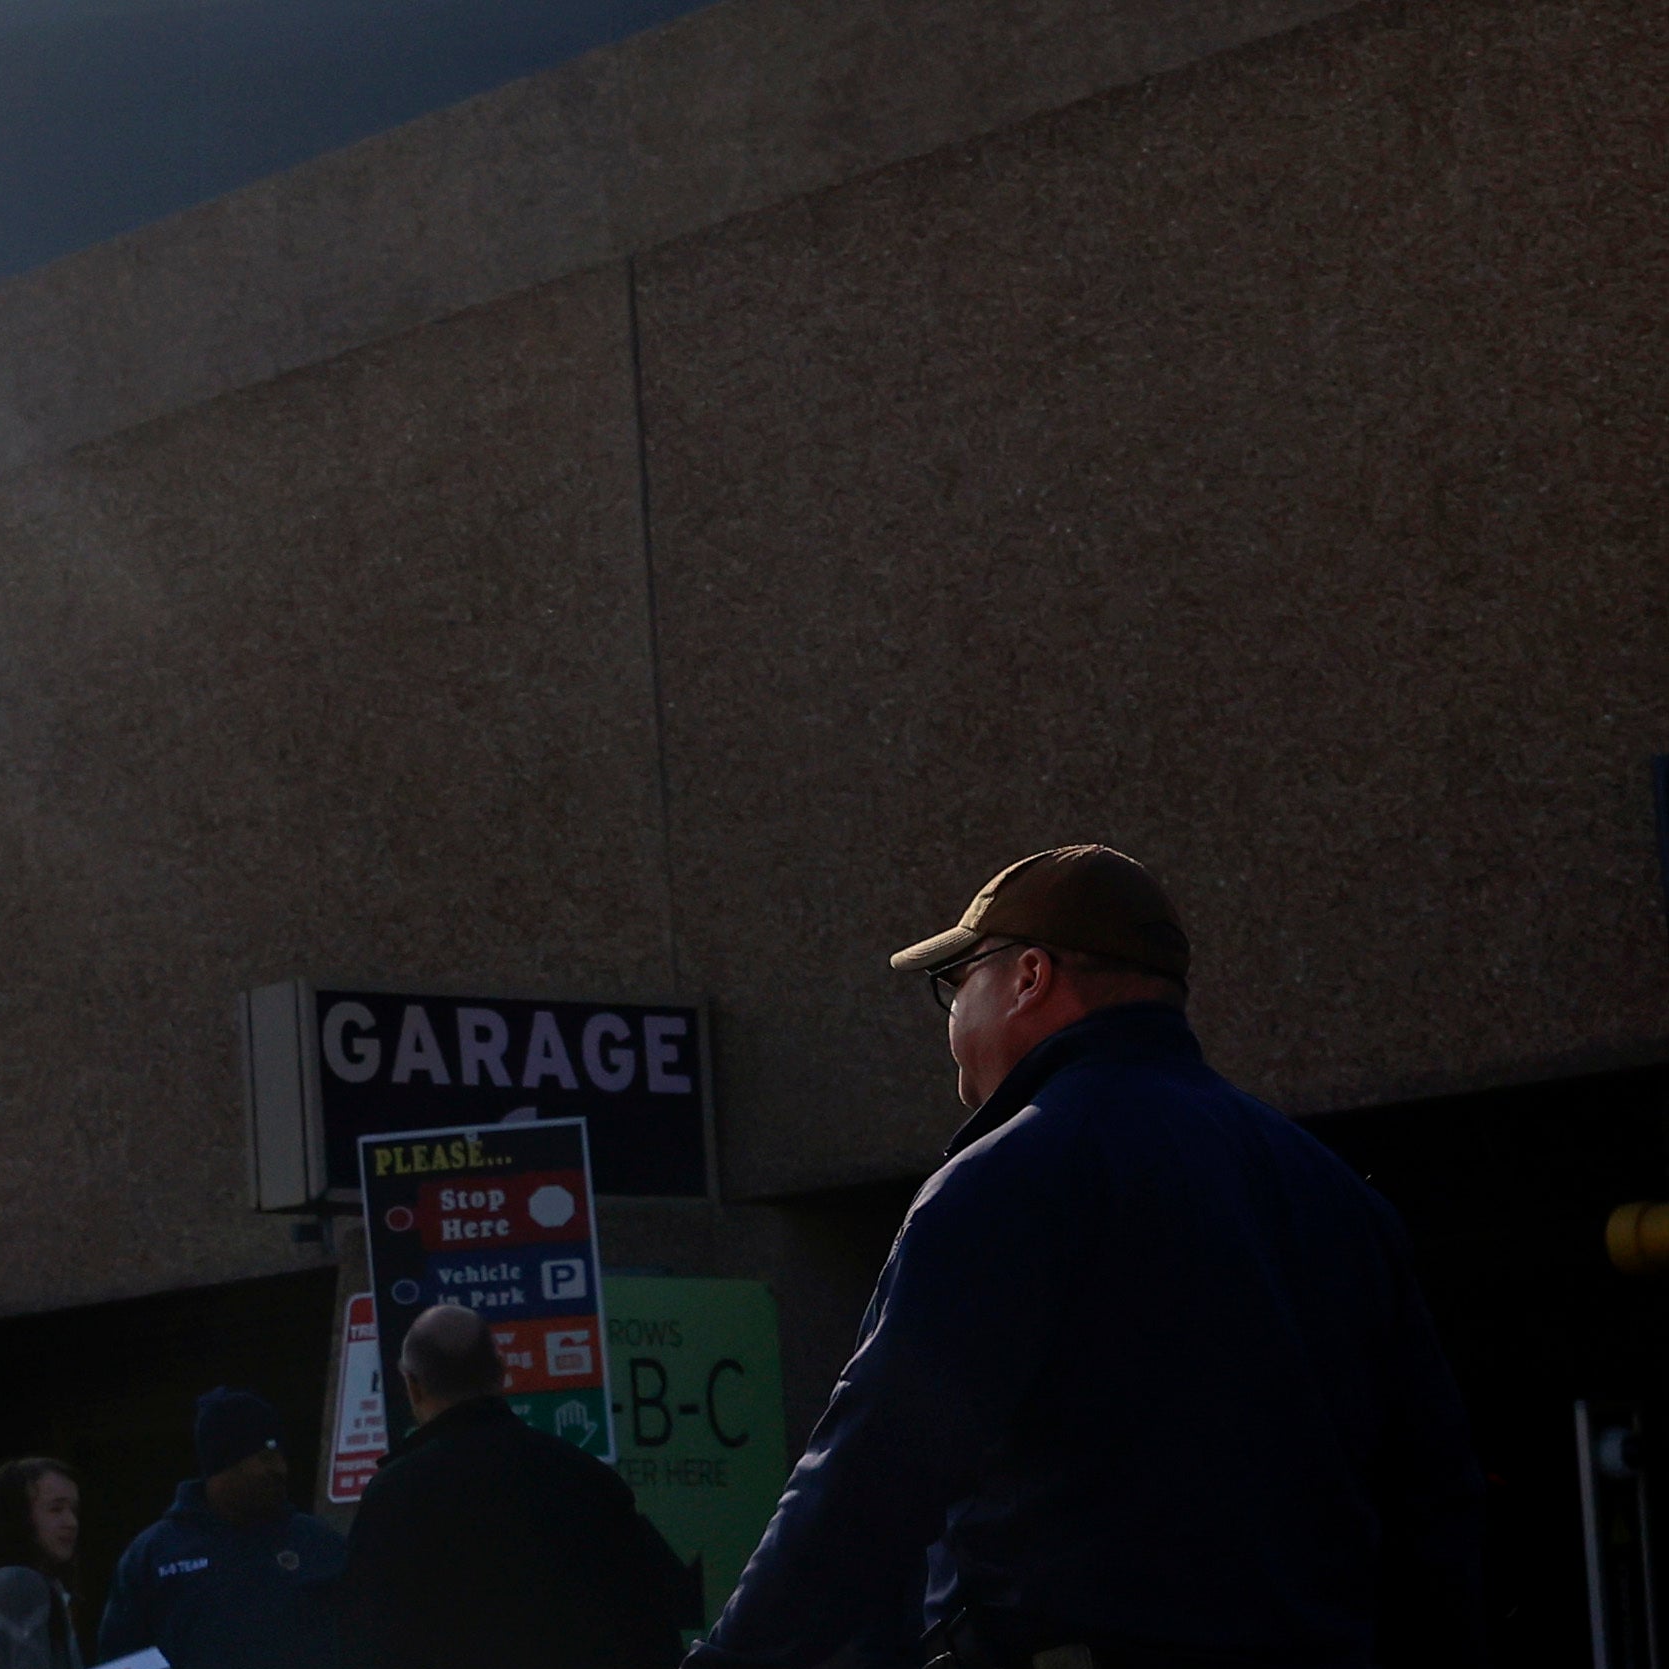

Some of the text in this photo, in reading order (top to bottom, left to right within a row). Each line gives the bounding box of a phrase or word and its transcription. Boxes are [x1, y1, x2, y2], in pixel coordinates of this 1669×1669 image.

[321, 1000, 694, 1095] GARAGE
[438, 1187, 506, 1213] Stop
[440, 1217, 511, 1242] Here
[436, 1262, 524, 1286] Vehicle
[469, 1286, 527, 1309] Park
